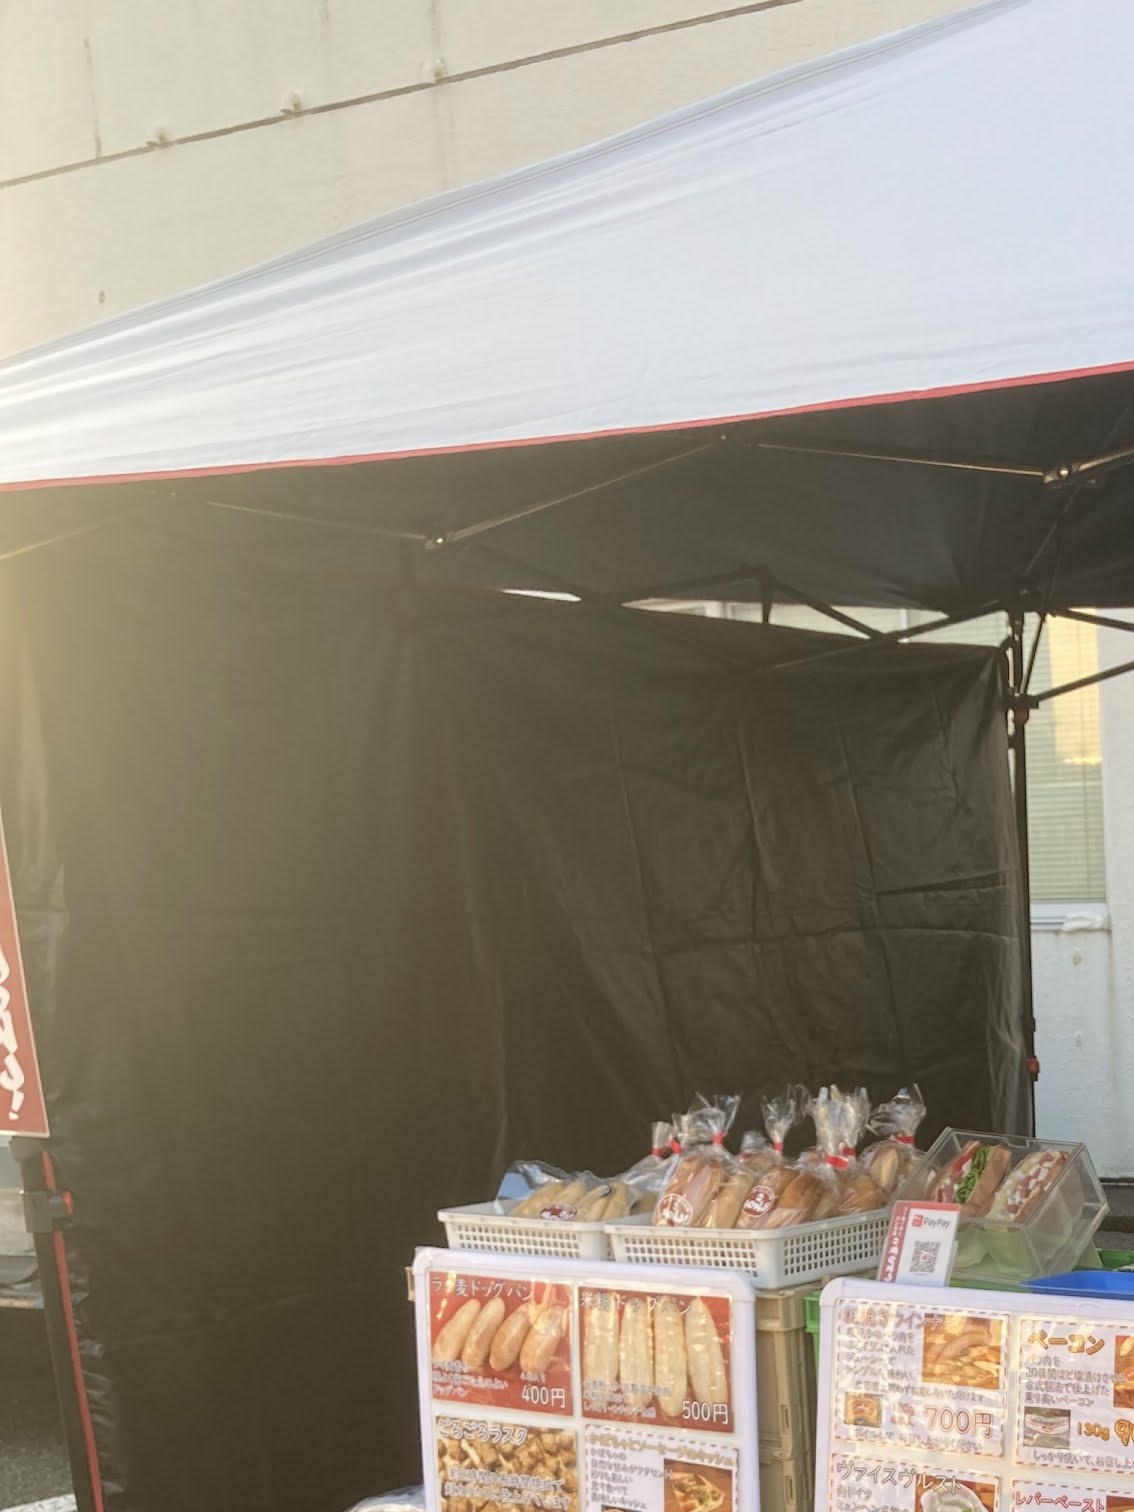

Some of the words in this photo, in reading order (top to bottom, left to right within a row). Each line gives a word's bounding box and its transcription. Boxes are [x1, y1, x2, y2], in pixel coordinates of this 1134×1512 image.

[923, 1217, 952, 1228] PayPay
[1026, 1329, 1105, 1356] ベーコン
[521, 1384, 566, 1409] 400円
[681, 1400, 729, 1426] 500円
[925, 1404, 994, 1439] 700円
[438, 1418, 528, 1447] ごろごろラスク
[836, 1459, 962, 1496] ヴァイスヴルスト
